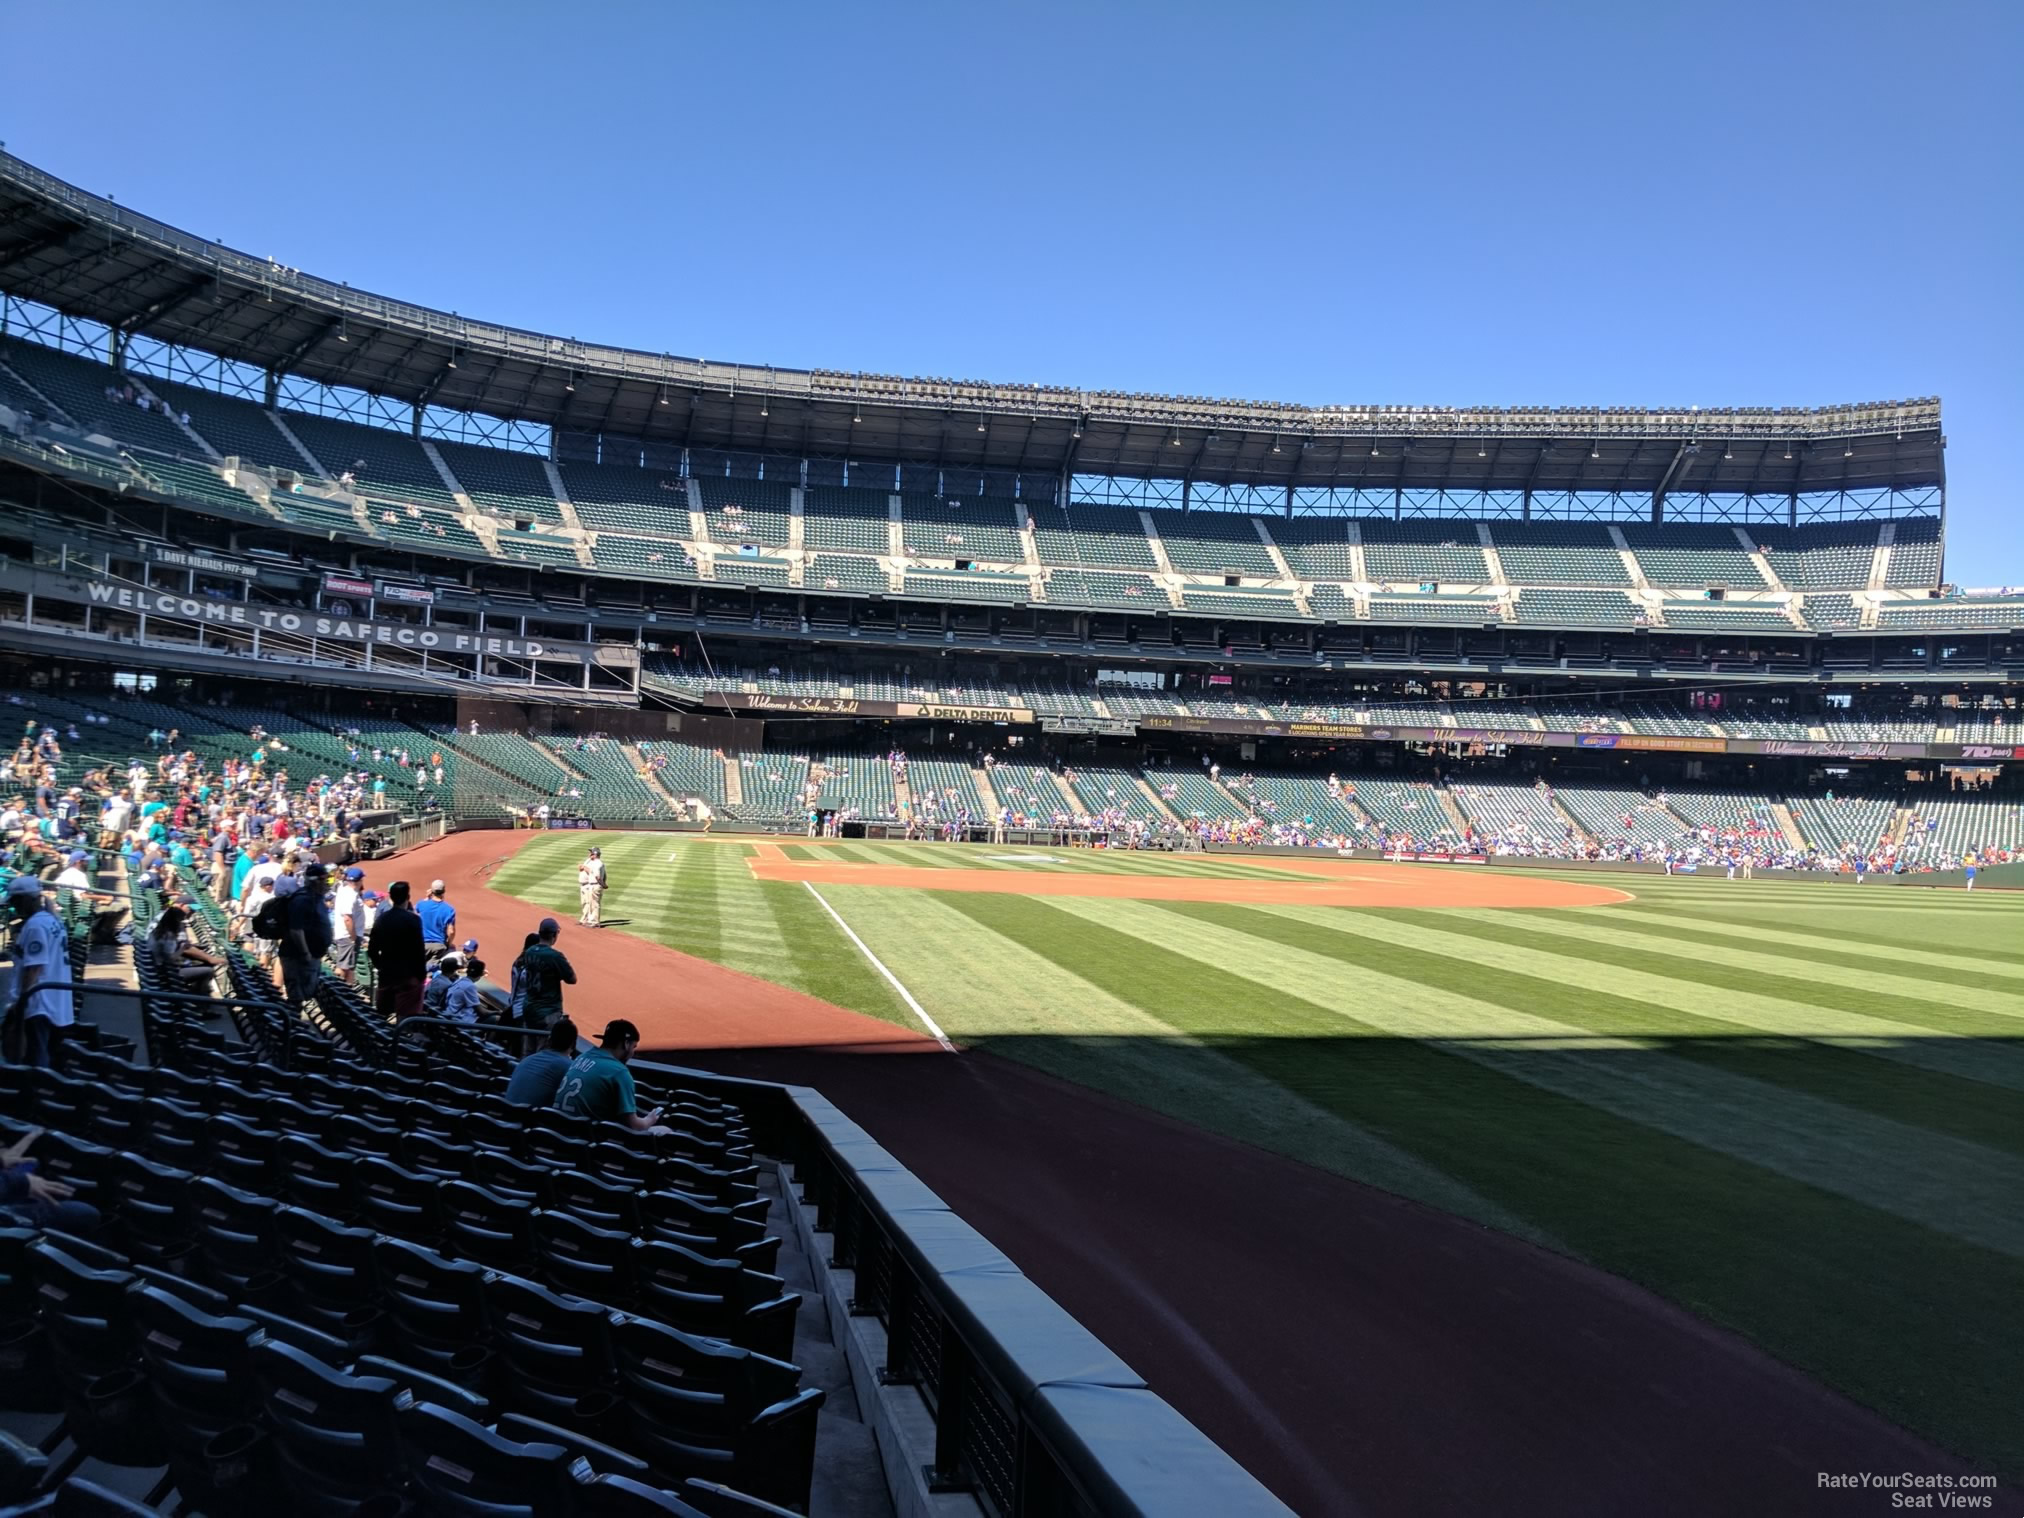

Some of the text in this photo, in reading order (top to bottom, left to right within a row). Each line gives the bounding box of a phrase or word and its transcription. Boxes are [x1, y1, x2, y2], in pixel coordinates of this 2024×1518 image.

[164, 551, 186, 564] DAVE
[188, 555, 223, 571] NIEHAUS
[88, 582, 543, 656] WELCOME TO SAFECO FIELD
[748, 695, 859, 713] Welcome to Safeco Field
[934, 708, 1016, 721] DELTA DENTAL
[1149, 718, 1172, 727] 11:34
[1433, 729, 1544, 744] Welcome to Safeco Field
[1765, 741, 1889, 756] Welcome to Safeco Field
[1961, 746, 1993, 758] 710
